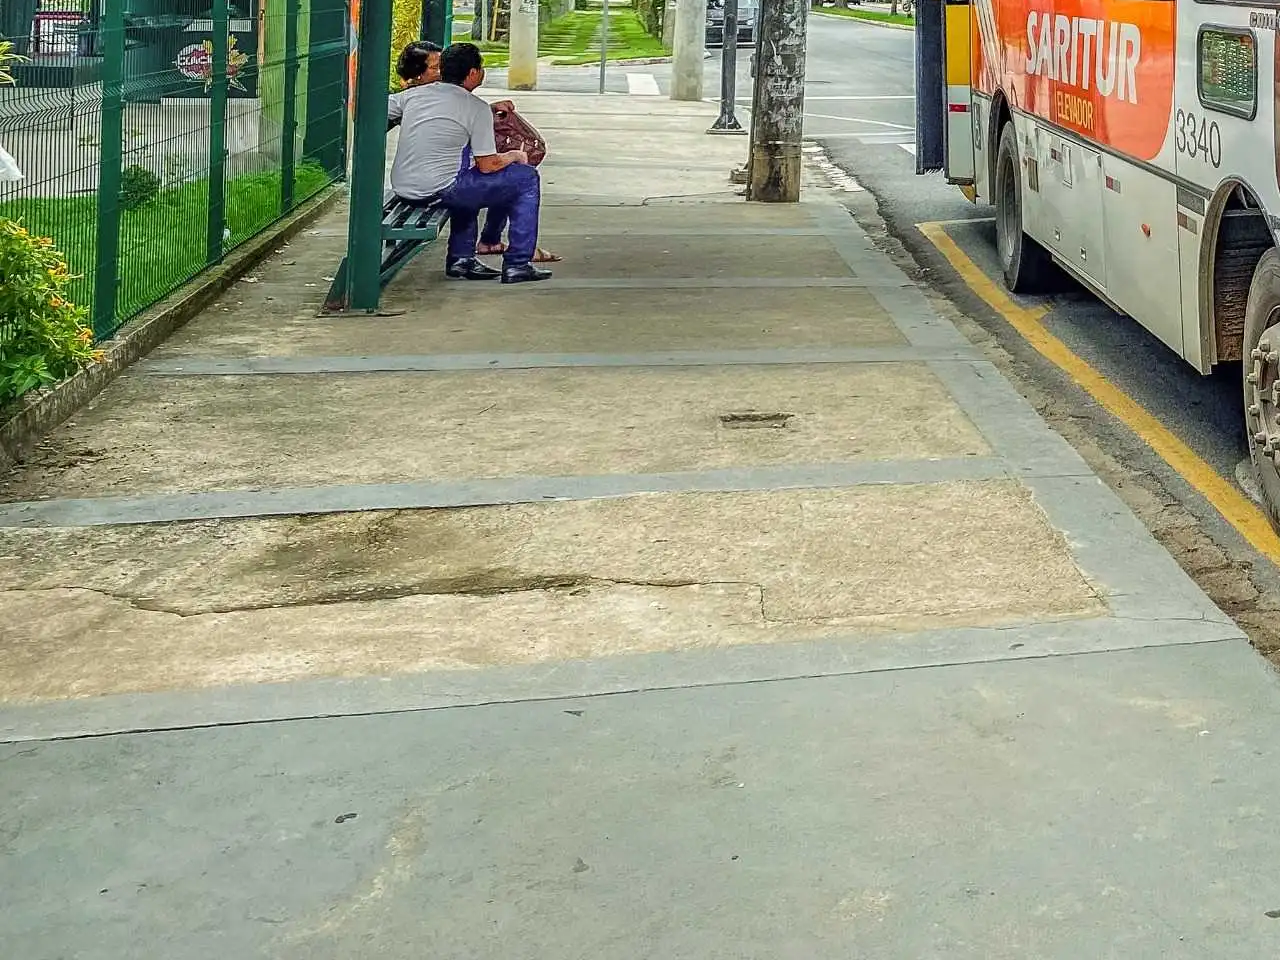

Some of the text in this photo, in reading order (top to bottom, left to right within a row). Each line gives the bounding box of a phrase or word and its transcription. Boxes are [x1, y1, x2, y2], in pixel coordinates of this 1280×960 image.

[1025, 10, 1141, 105] SARITUR
[1056, 90, 1095, 132] ELEVADOR
[1176, 108, 1222, 169] 3340
